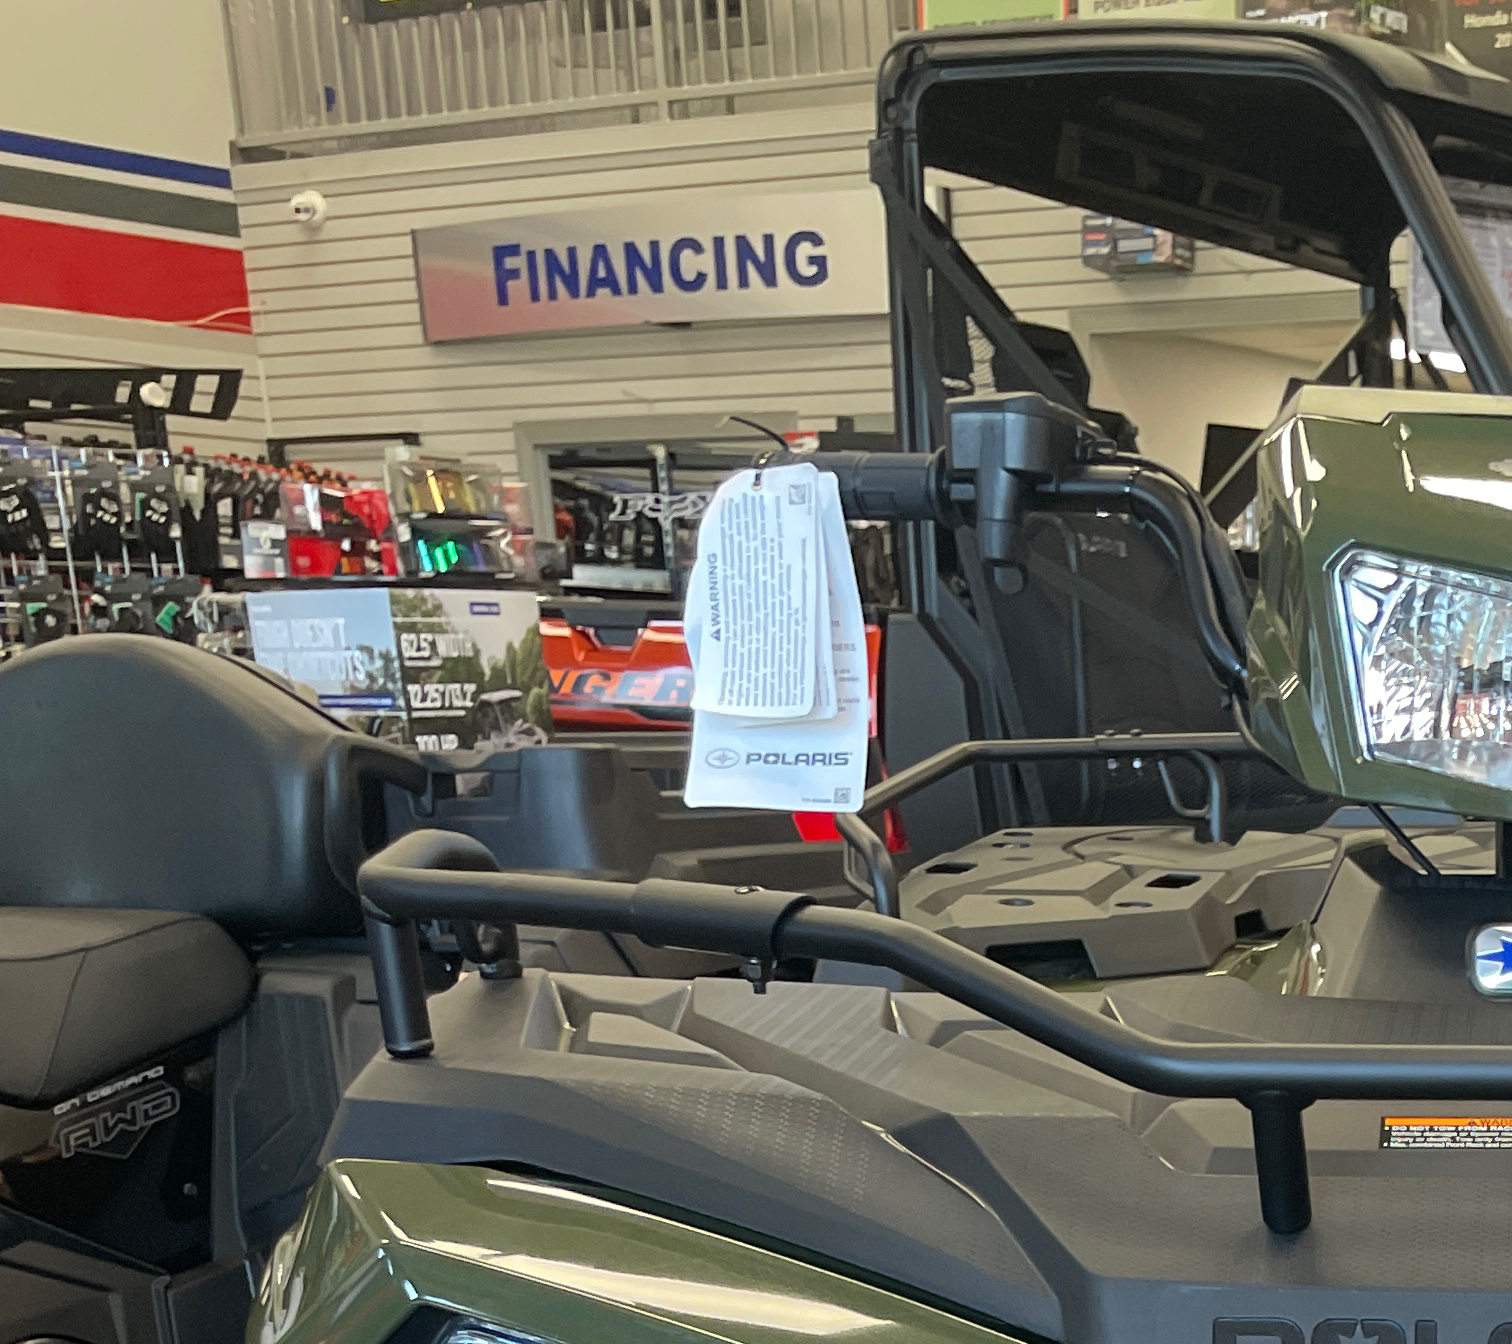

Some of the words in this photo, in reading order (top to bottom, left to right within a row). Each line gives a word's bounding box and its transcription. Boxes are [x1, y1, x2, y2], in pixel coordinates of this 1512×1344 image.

[1464, 10, 1509, 29] Honda
[492, 231, 829, 307] FINANCING
[707, 553, 722, 628] WARNING
[549, 670, 692, 701] NGER
[745, 752, 850, 767] POLARIS
[53, 1097, 80, 1116] ON
[86, 1066, 165, 1103] DEMAND
[60, 1087, 180, 1159] AWD
